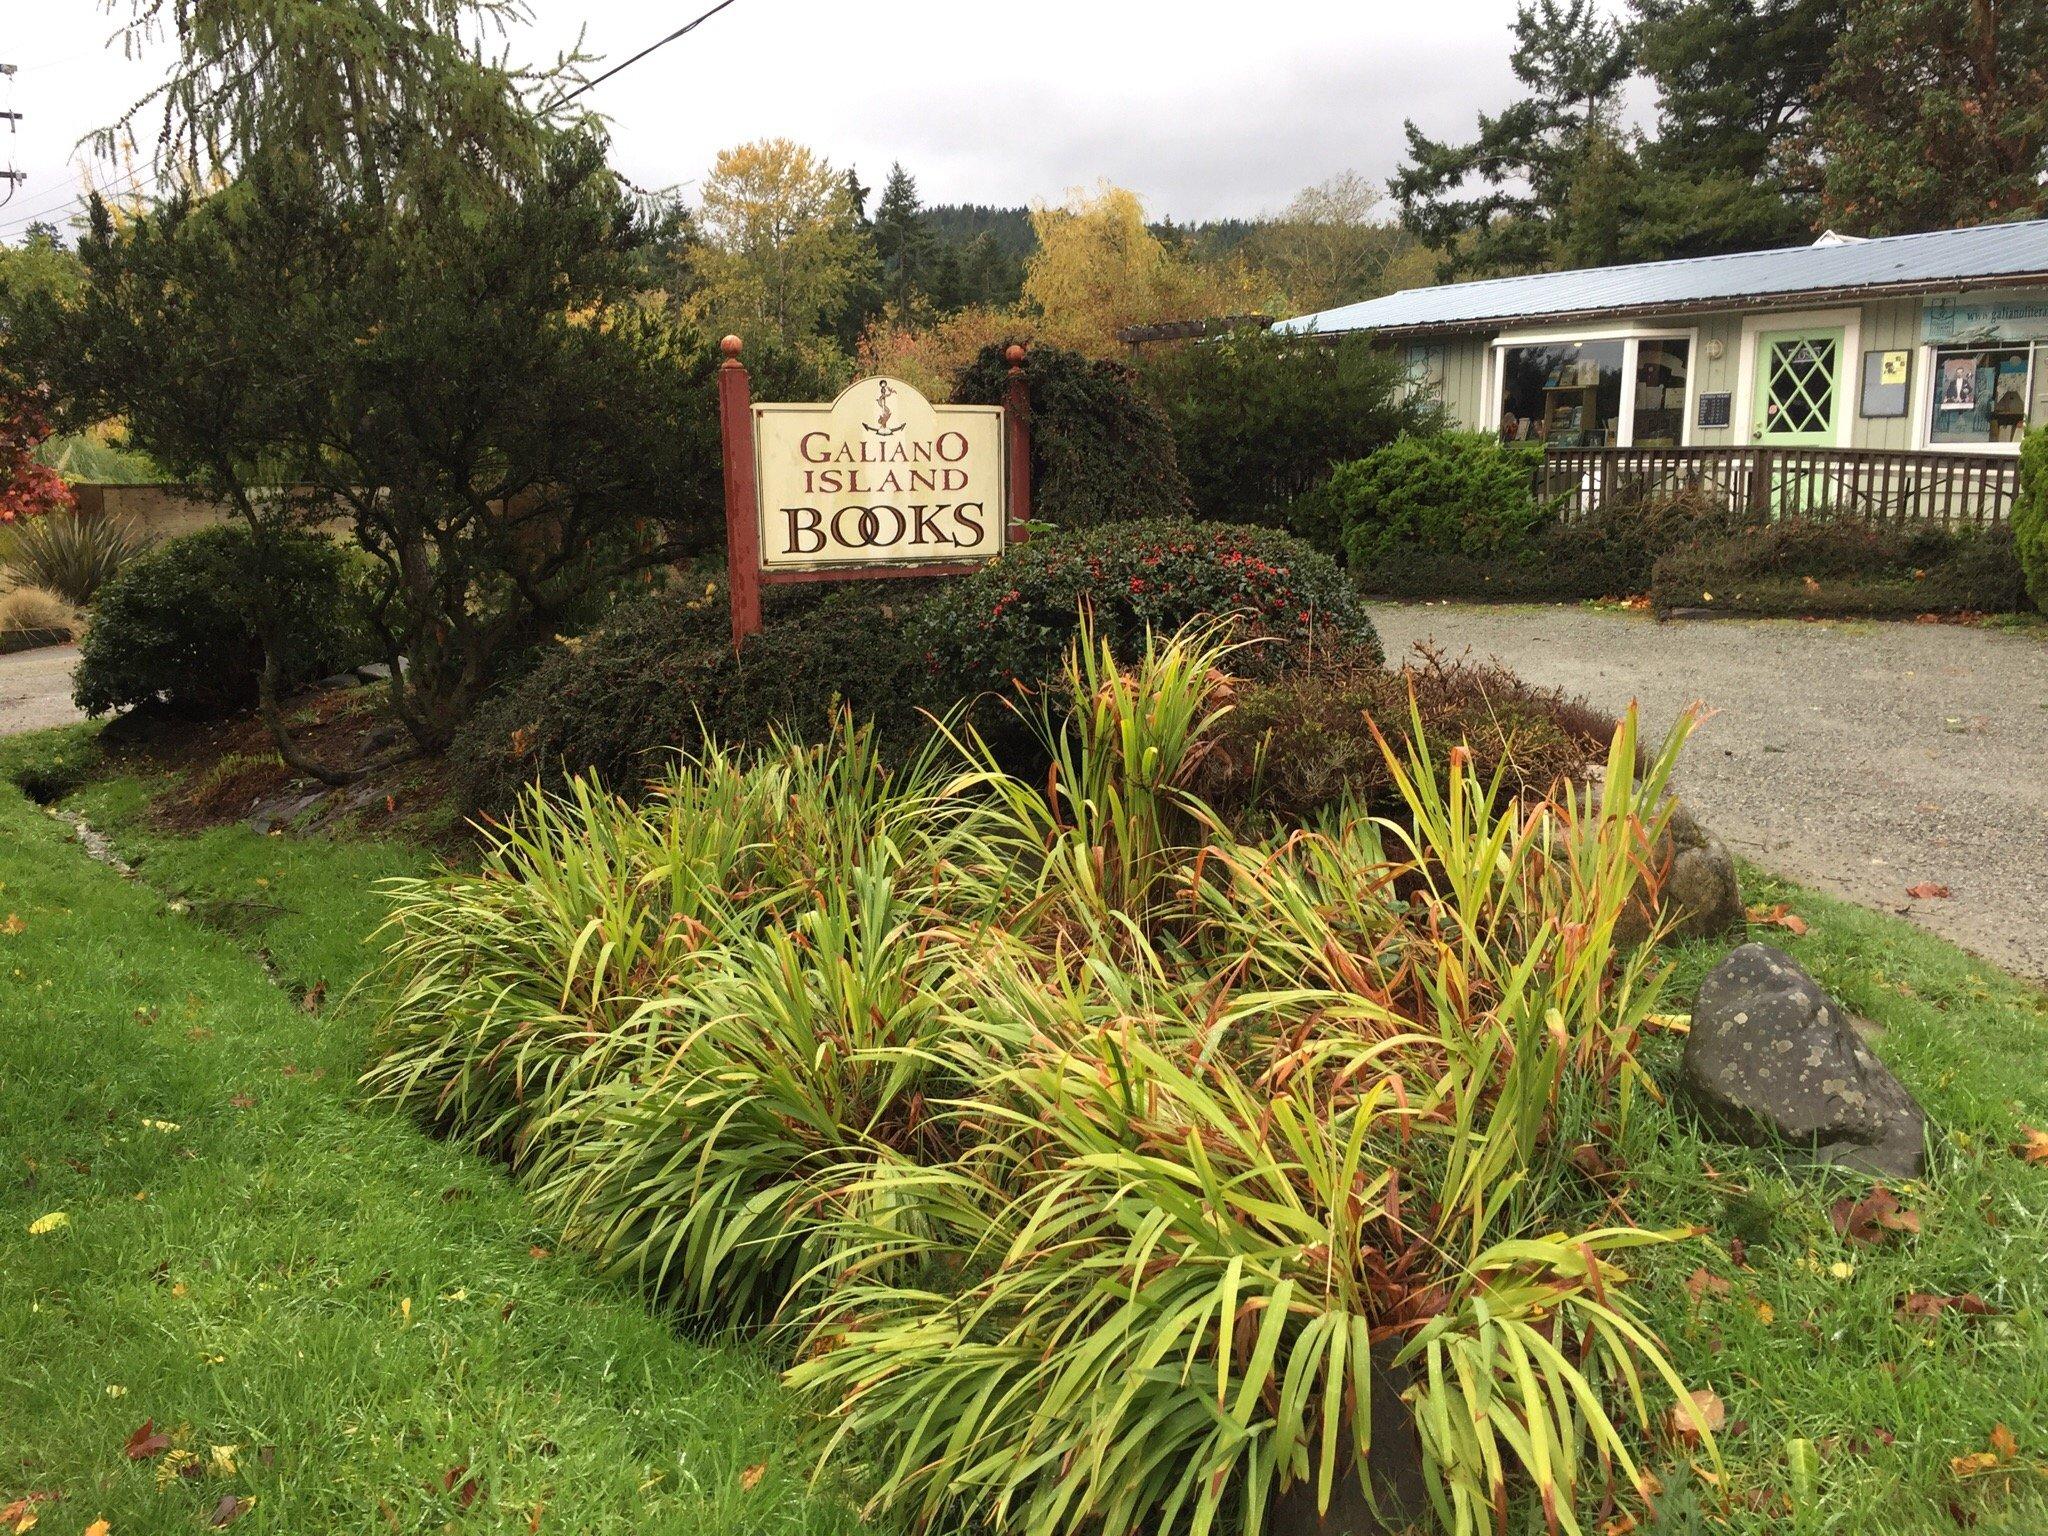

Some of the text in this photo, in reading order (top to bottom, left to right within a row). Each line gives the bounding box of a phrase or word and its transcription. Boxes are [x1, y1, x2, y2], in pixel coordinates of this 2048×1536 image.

[800, 432, 969, 463] GALIANO
[805, 469, 969, 493] ISLAND
[780, 502, 985, 554] BOOKS
